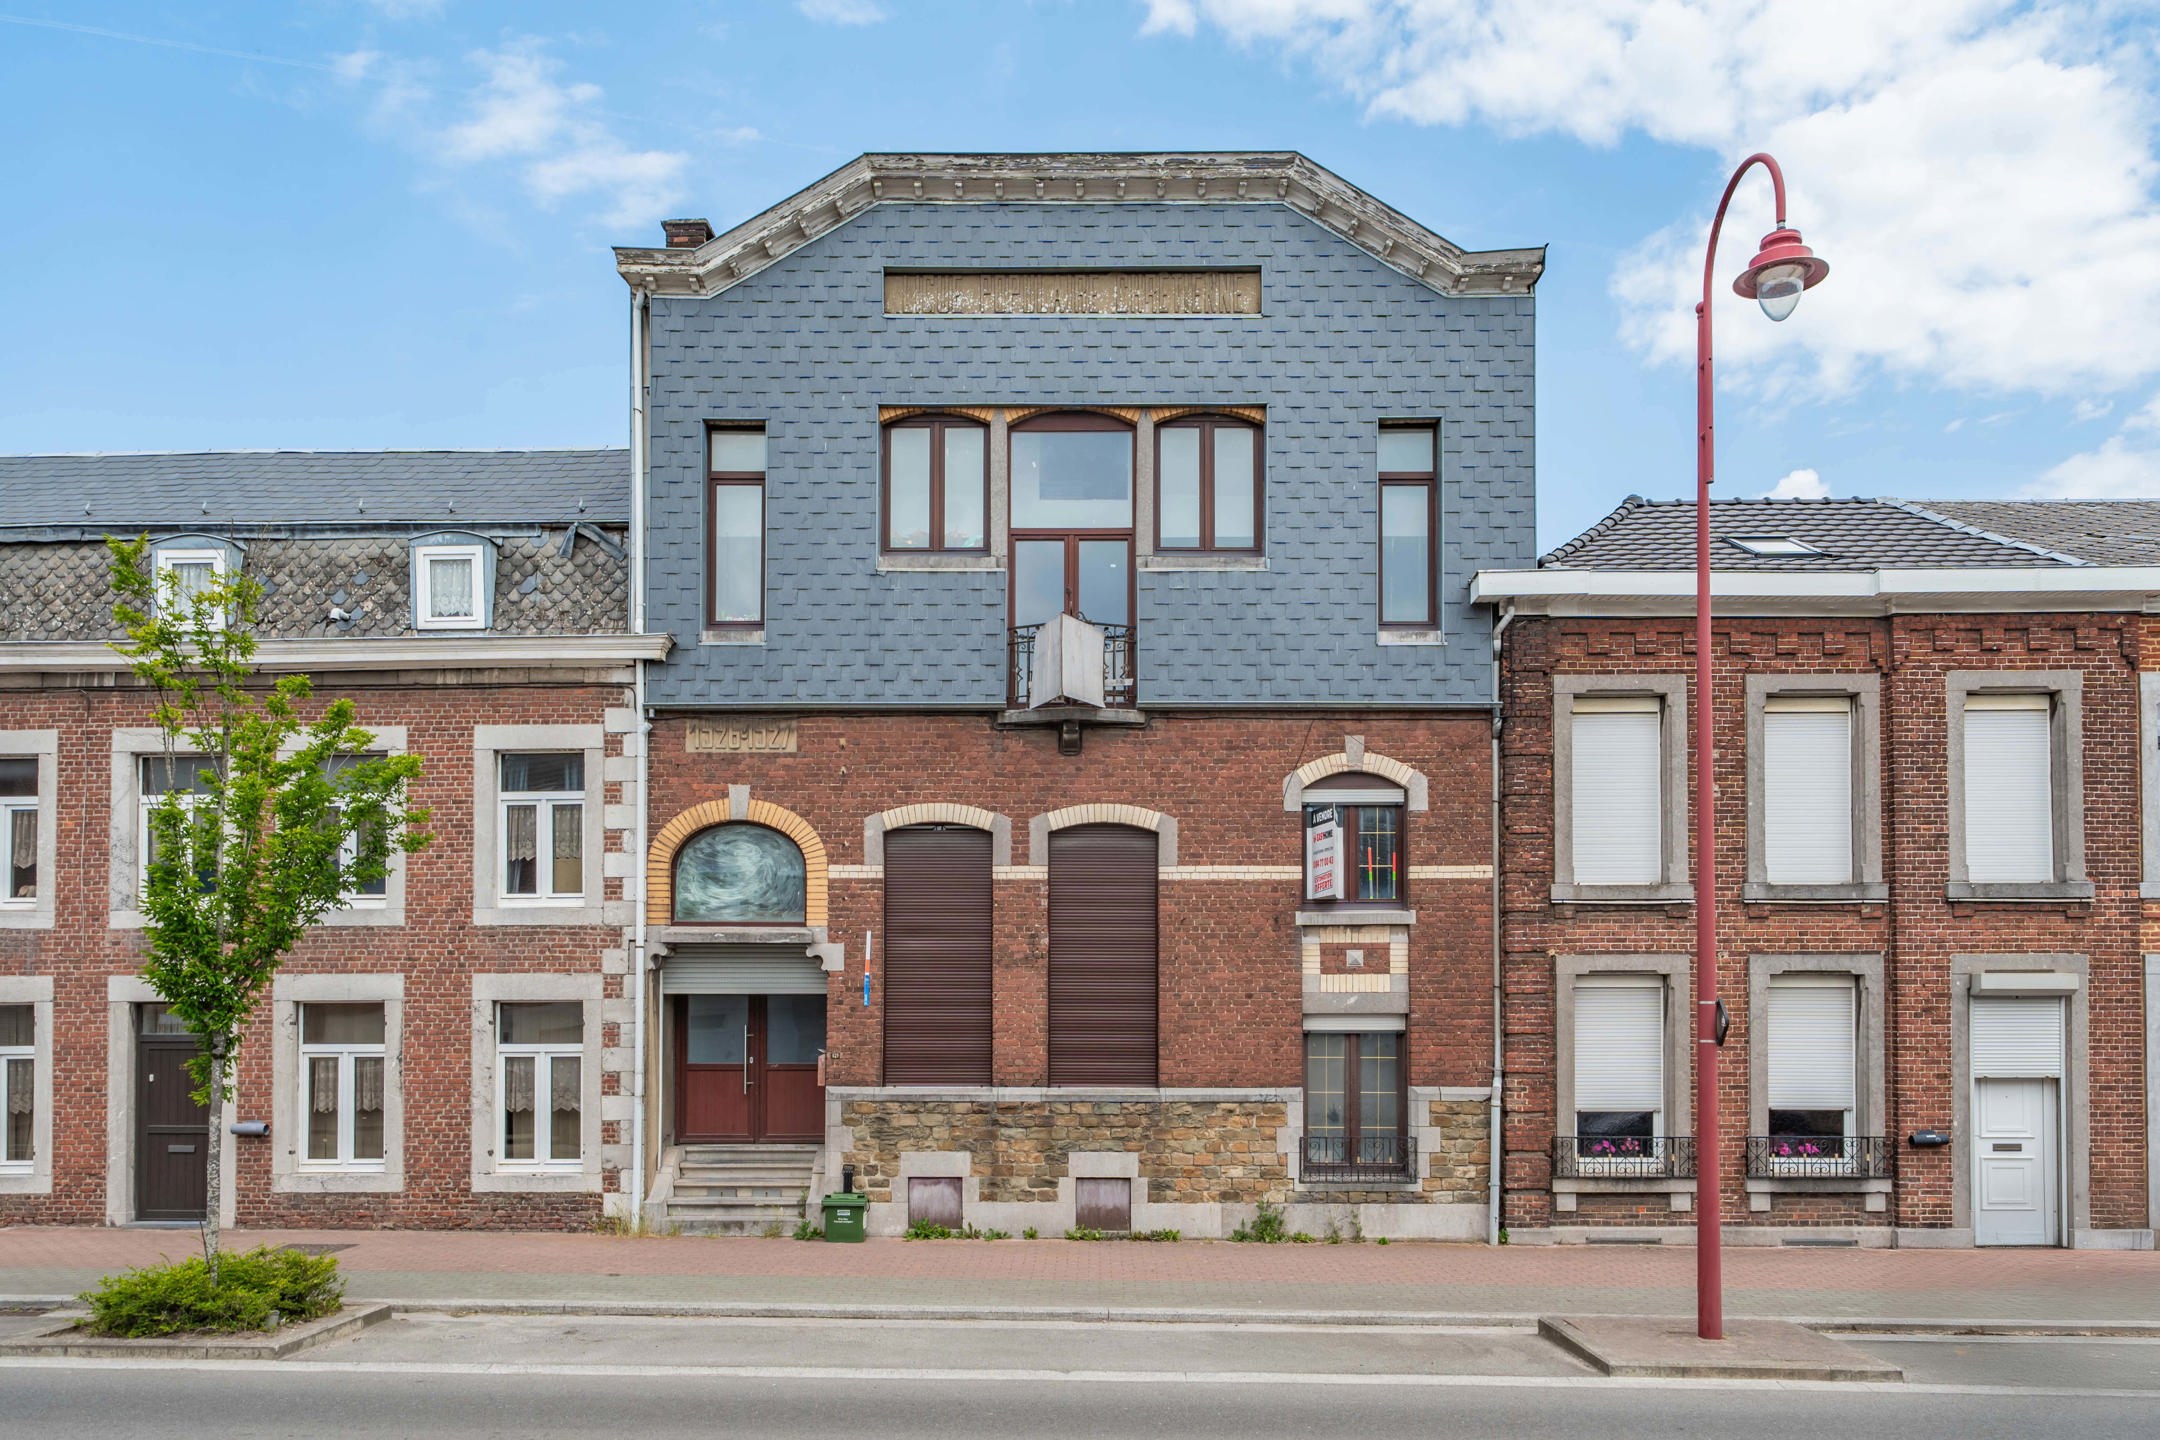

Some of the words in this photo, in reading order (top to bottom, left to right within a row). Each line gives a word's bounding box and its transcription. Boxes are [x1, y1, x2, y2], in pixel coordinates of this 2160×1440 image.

[902, 272, 963, 314] LIGUE
[981, 272, 1099, 314] POPULAIRE
[1316, 808, 1333, 823] VENDRE
